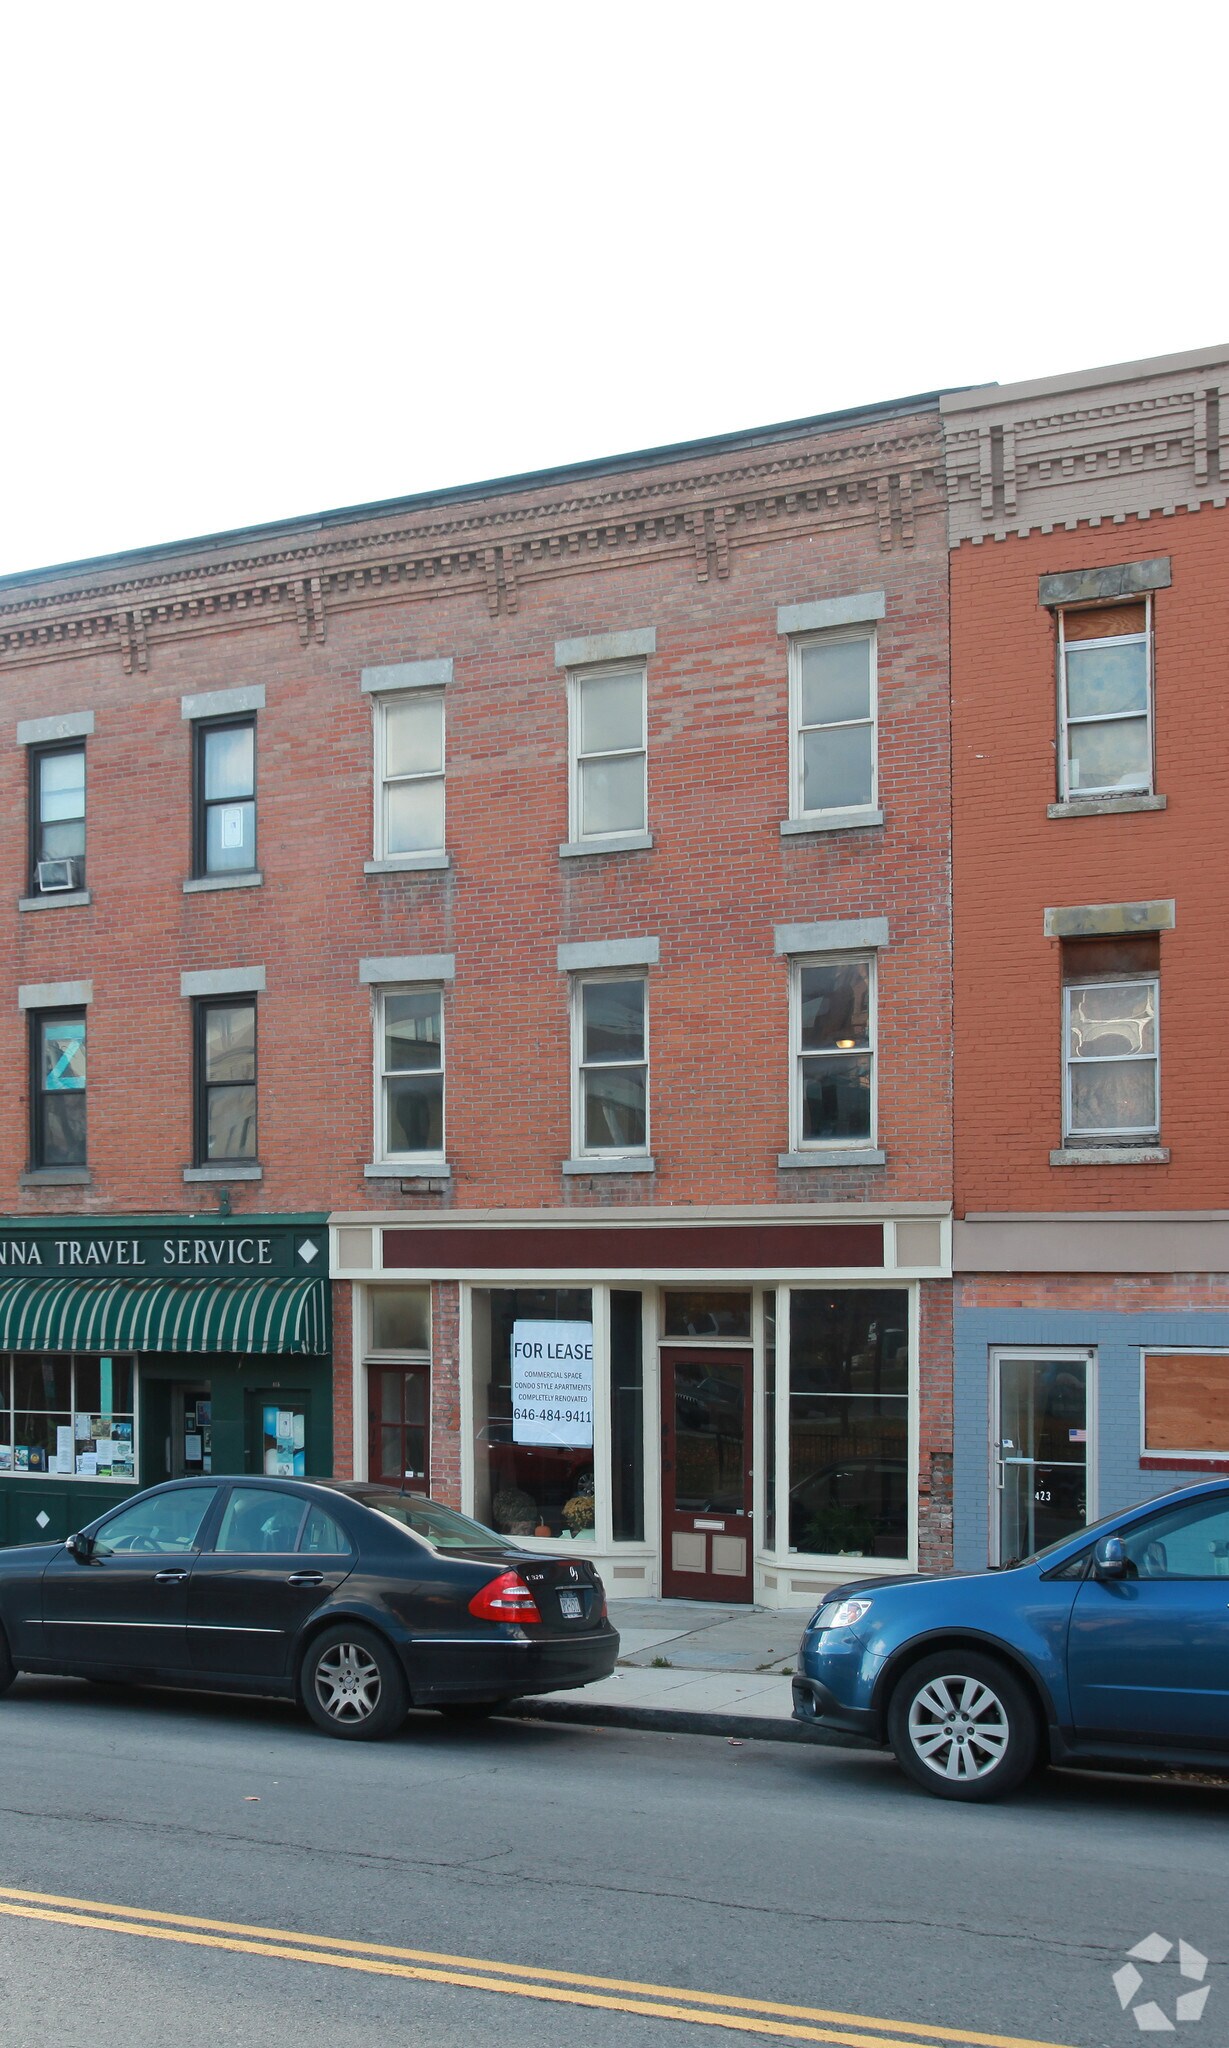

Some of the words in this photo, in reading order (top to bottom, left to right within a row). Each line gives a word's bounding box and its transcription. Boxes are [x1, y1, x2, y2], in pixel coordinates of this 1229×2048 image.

[55, 1240, 146, 1265] TRAVEL
[162, 1239, 273, 1264] SERVICE
[514, 1342, 543, 1359] FOR
[547, 1343, 593, 1360] LEASE
[524, 1370, 563, 1379] COMMERCIAL
[564, 1372, 582, 1380] SPACE
[514, 1381, 536, 1390] CONDO
[536, 1382, 553, 1390] STYLE
[554, 1383, 592, 1392] APARTMENTS
[518, 1393, 554, 1402] COMPLETELY
[555, 1394, 588, 1403] RENOVATED
[513, 1408, 592, 1423] 646-484-9411
[1034, 1490, 1051, 1501] 423
